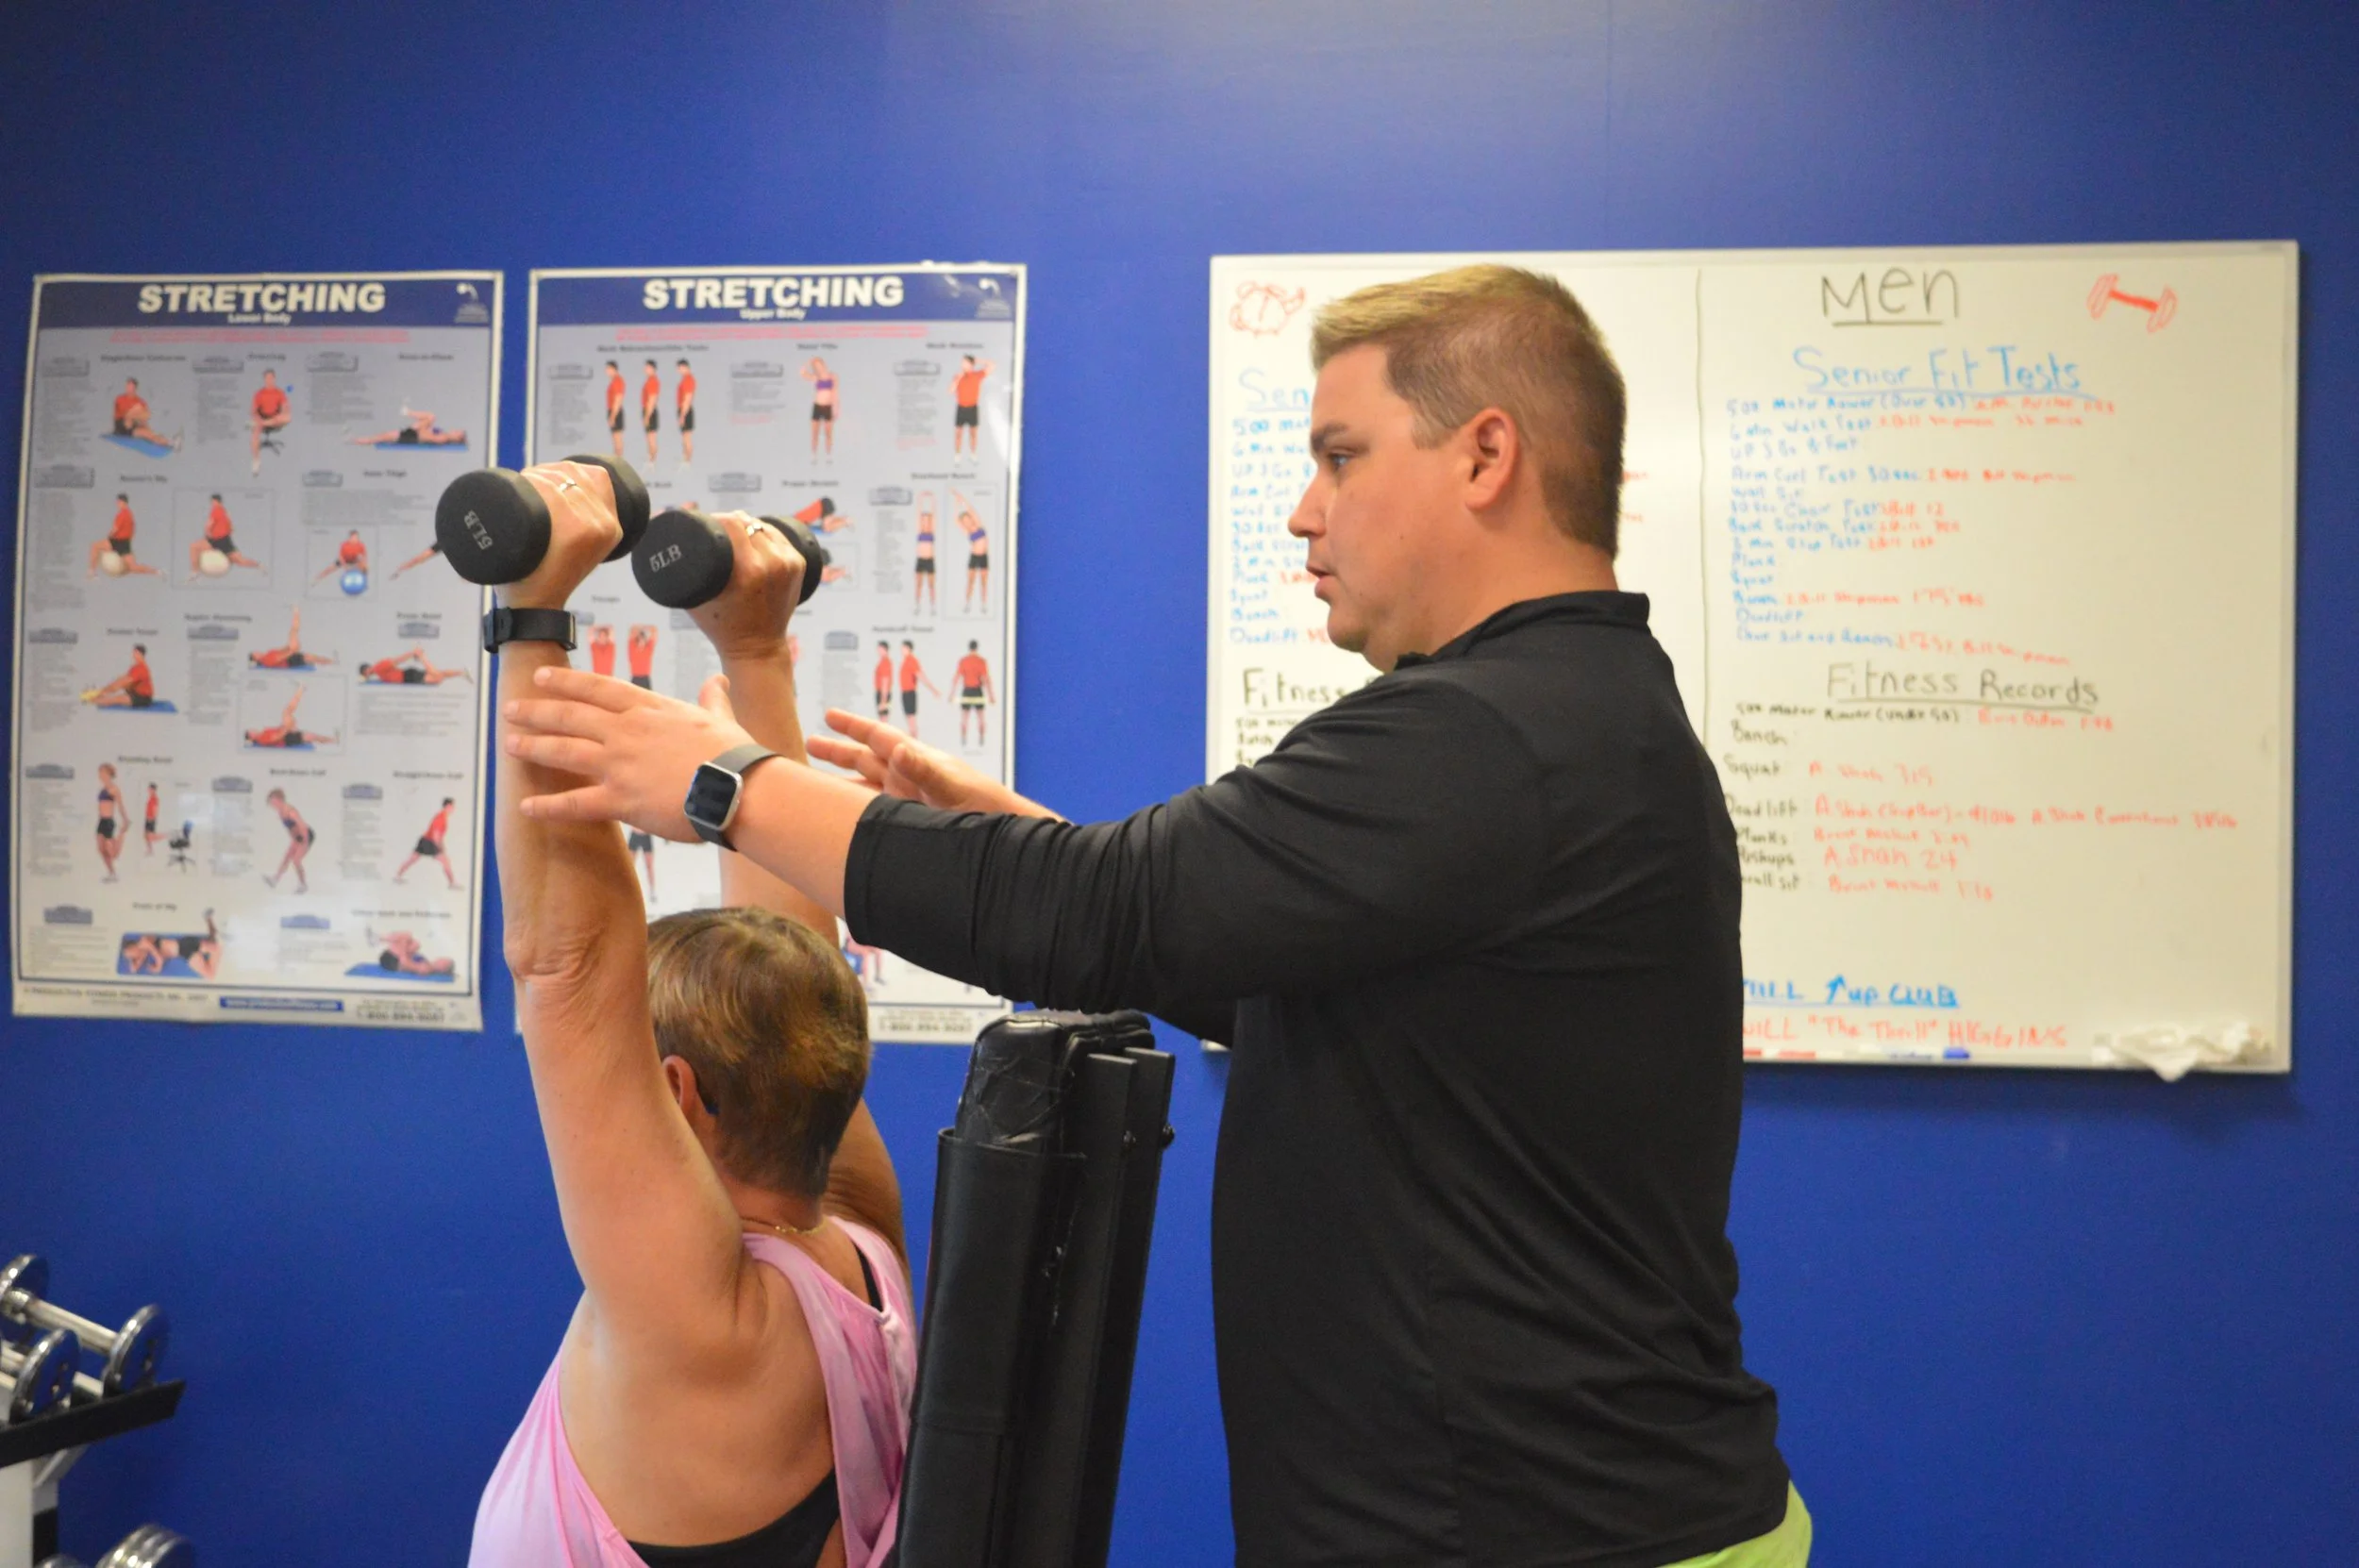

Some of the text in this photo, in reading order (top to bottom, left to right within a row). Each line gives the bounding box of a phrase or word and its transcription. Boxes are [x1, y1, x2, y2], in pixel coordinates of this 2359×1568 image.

[138, 283, 387, 313] STRETCHING
[643, 276, 904, 309] STRETCHING
[1821, 267, 1959, 324] Men
[227, 313, 292, 325] Lower Body
[740, 308, 806, 321] Upper Body
[1793, 345, 2081, 390] Senior Fit Tests
[1238, 367, 1309, 409] Sen
[464, 510, 493, 550] 5LB
[649, 544, 682, 573] 5LB
[1828, 661, 2099, 705] Fitness Records
